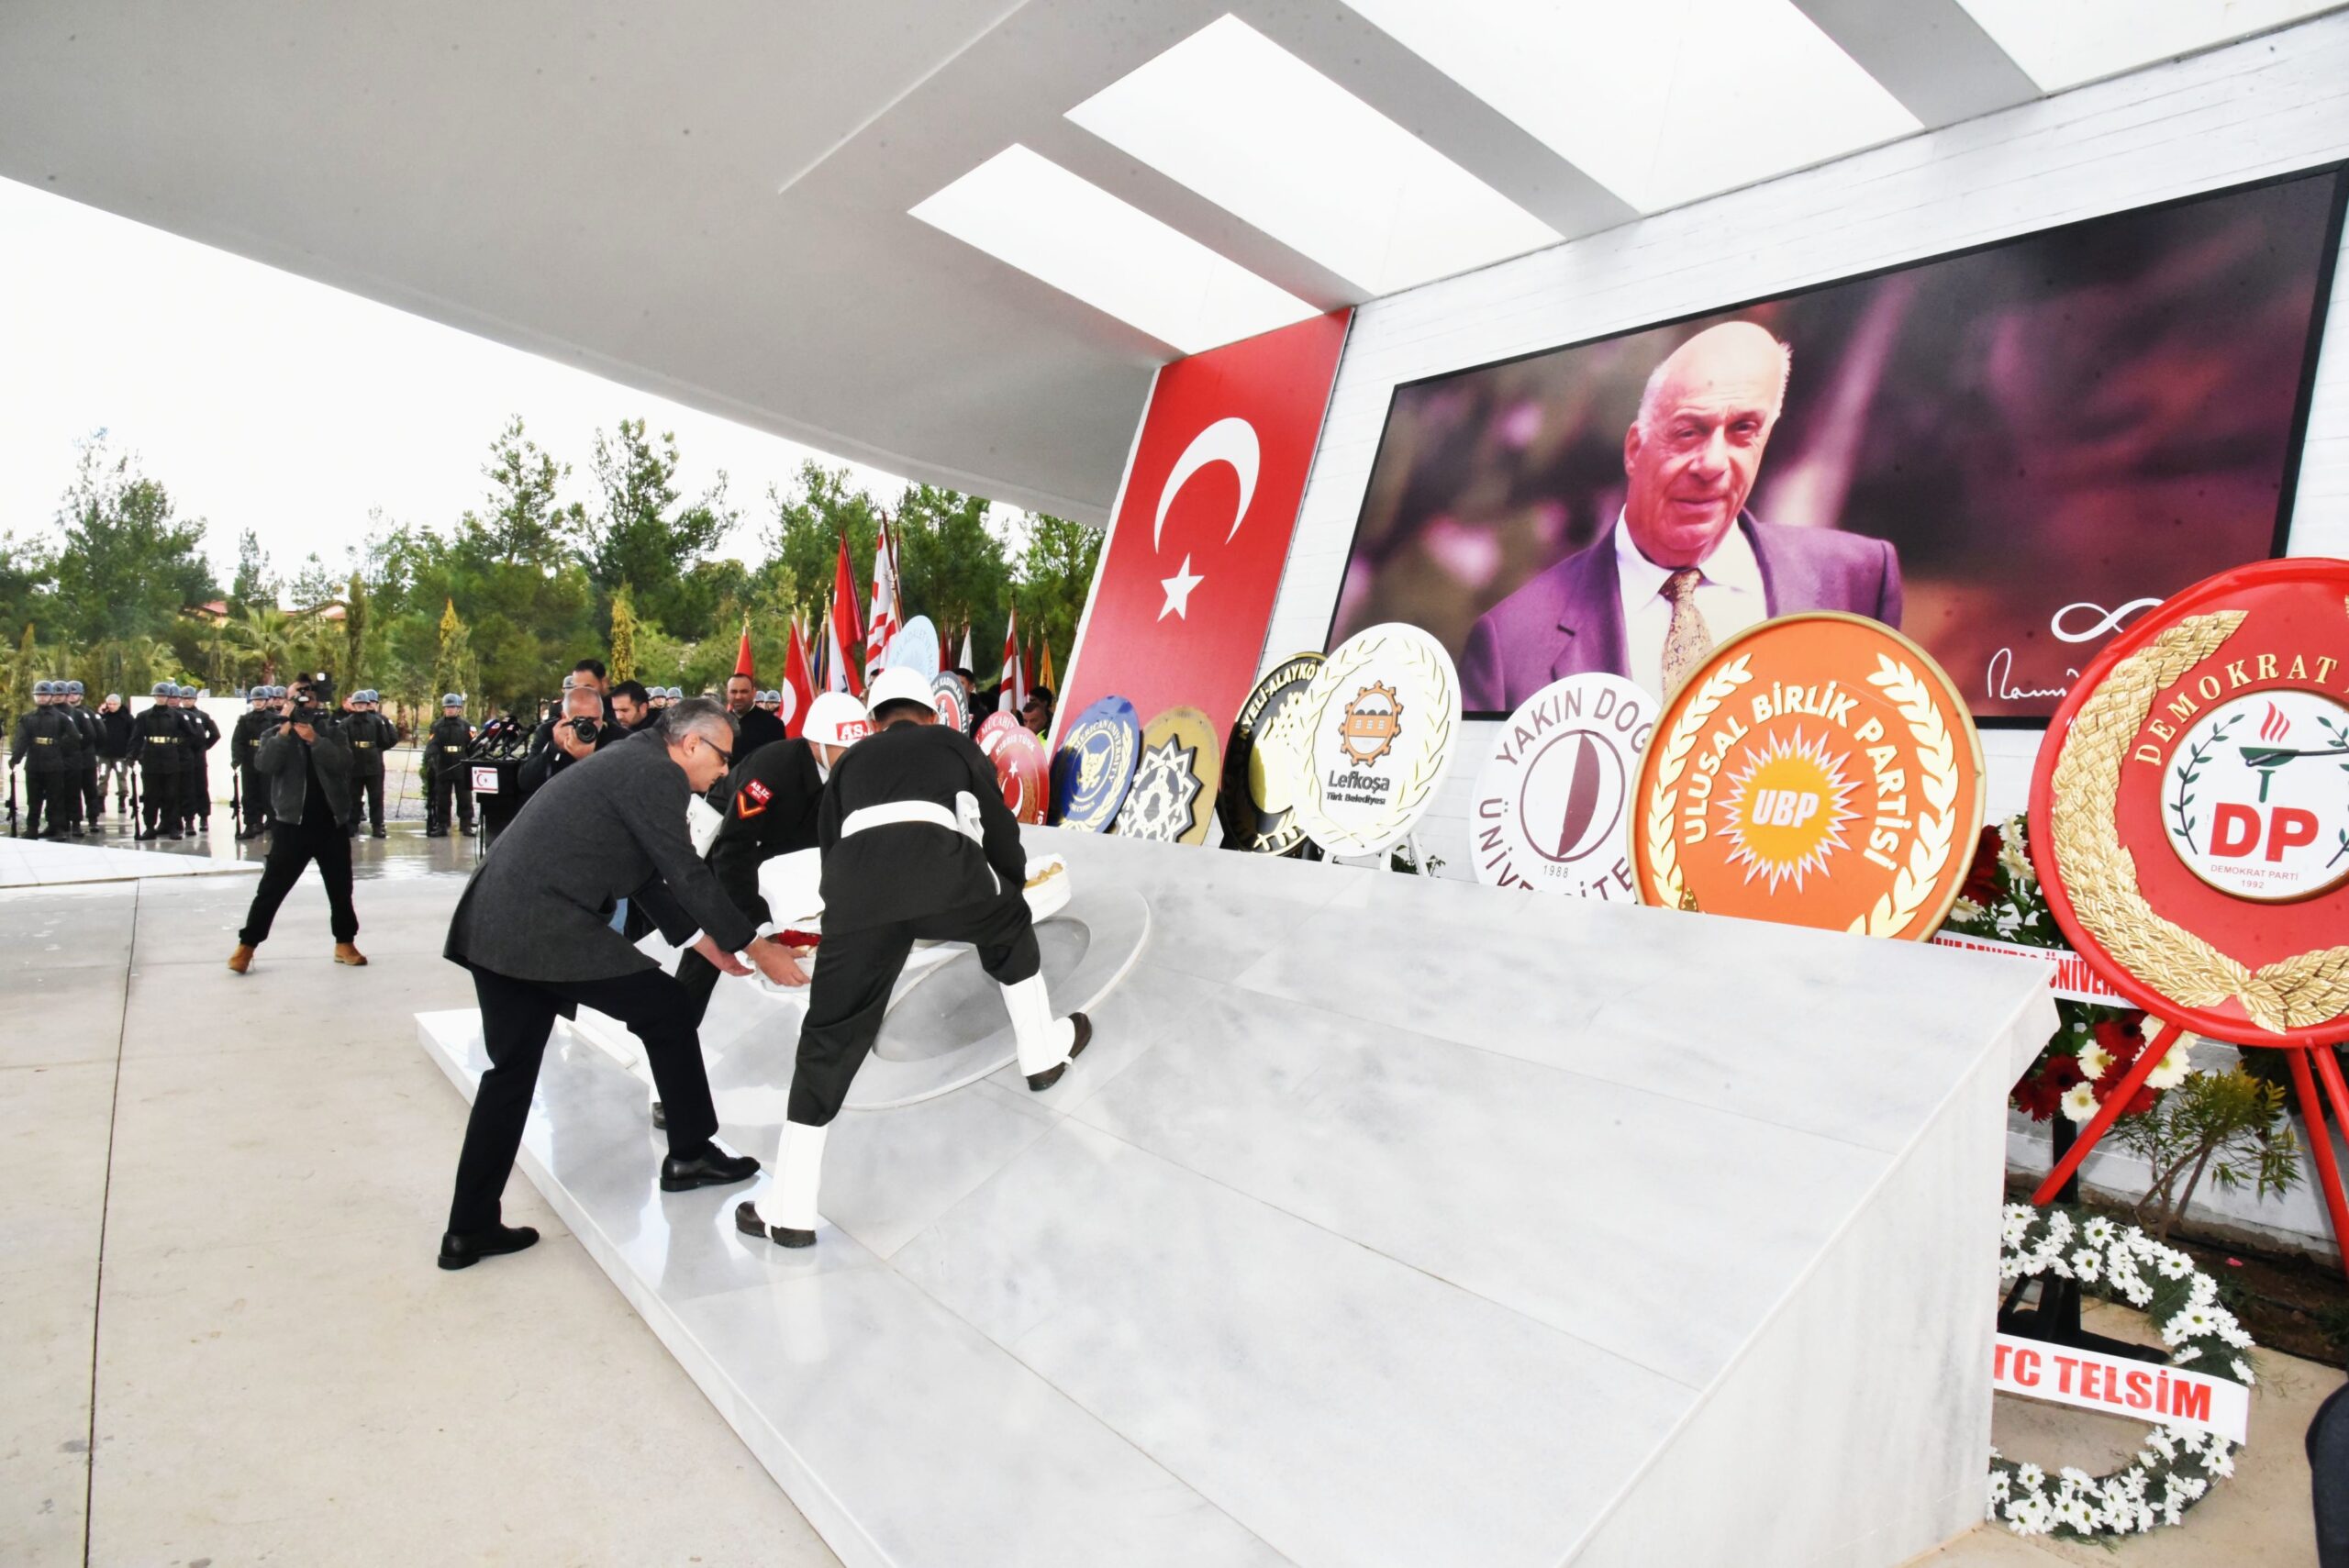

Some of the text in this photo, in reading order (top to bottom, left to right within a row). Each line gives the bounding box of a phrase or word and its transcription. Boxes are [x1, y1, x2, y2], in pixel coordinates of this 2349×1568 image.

[1495, 687, 1582, 766] YAKIN
[2134, 653, 2338, 767] DEMOKRAT
[1327, 792, 1343, 801] Türk
[1328, 770, 1390, 795] Lefkoşa
[1685, 681, 1913, 873] ULUSAL BİRLİK PARTİSİ
[1752, 789, 1820, 828] UBP
[2209, 802, 2320, 863] DP
[1543, 865, 1569, 878] 1988
[2210, 864, 2266, 878] DEMOKRAT
[2242, 880, 2265, 889] 1992
[2054, 1355, 2213, 1422] TELSİM
